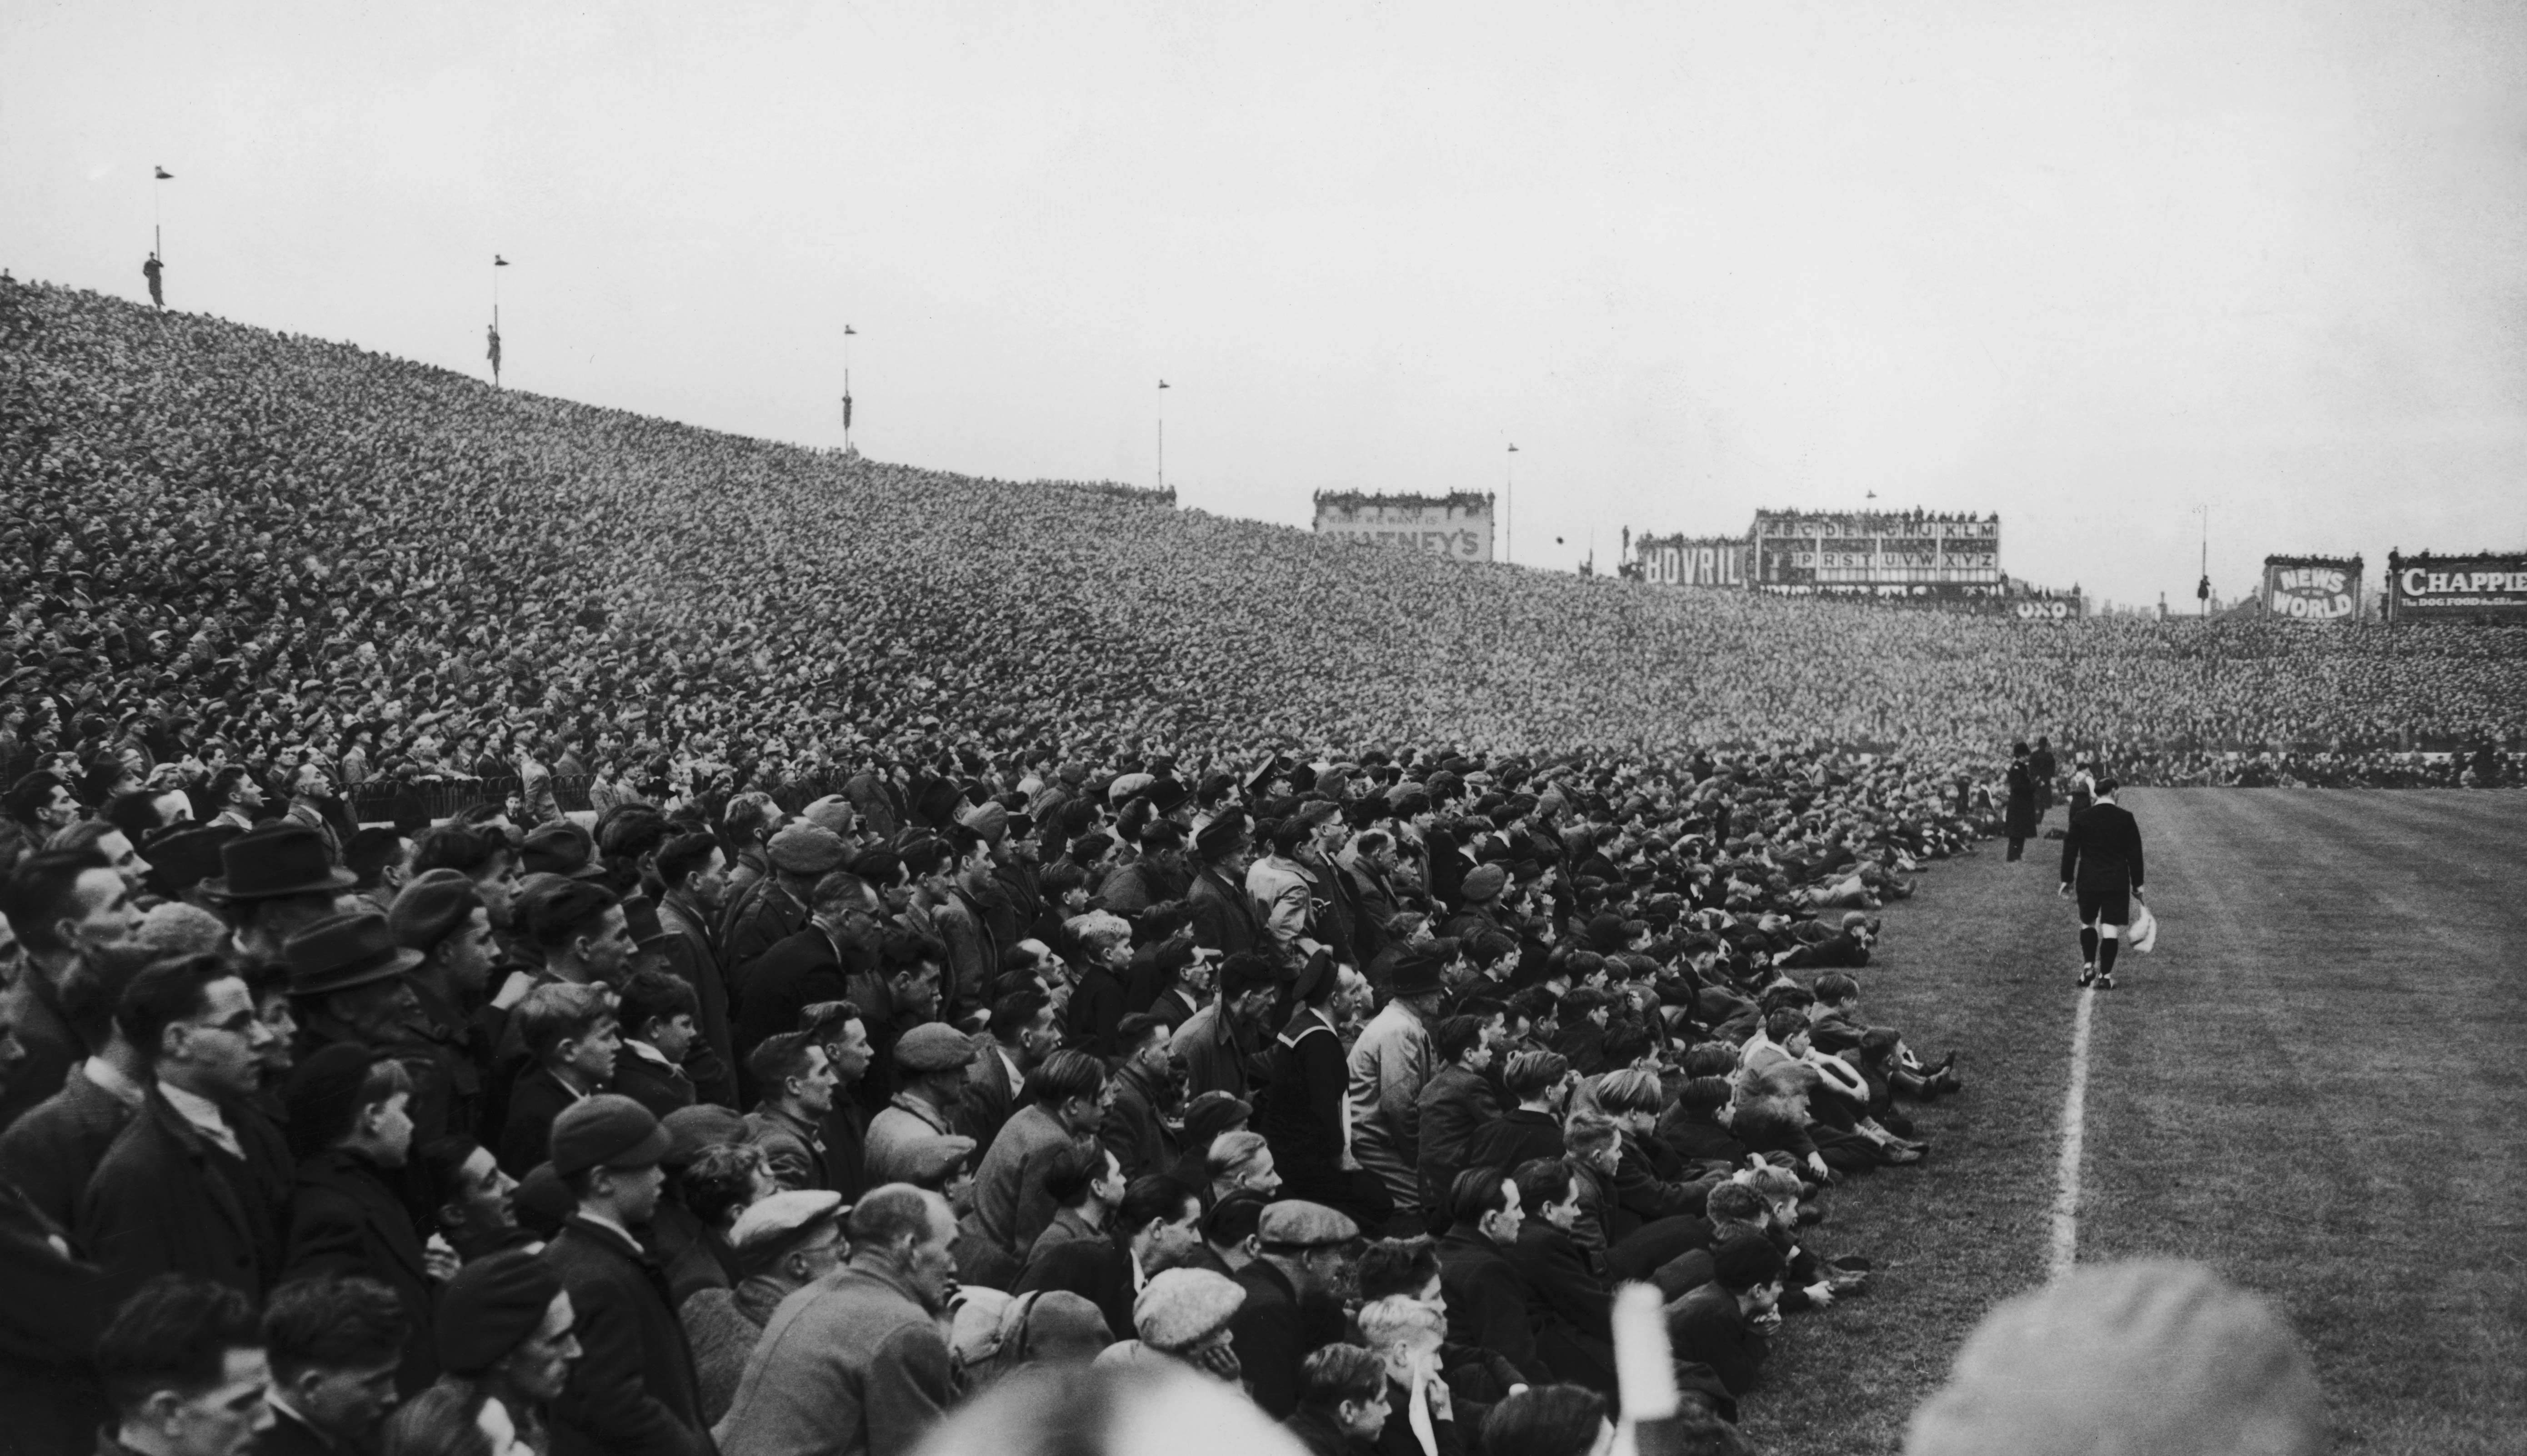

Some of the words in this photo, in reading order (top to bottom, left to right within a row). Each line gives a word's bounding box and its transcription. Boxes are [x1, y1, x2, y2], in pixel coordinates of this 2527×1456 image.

[1826, 524, 1835, 536] D
[1922, 524, 1932, 536] J
[1947, 524, 1955, 537] K
[1964, 525, 1974, 537] L
[1981, 525, 1994, 537] M
[1646, 547, 1740, 585] BOVRIL
[1803, 554, 1811, 566] P
[1825, 554, 1835, 566] R
[1843, 554, 1853, 566] S
[1862, 554, 1871, 566] T
[1886, 554, 1895, 565] U
[1903, 554, 1913, 565] V
[1920, 554, 1933, 565] W
[1945, 553, 1955, 566] X
[1962, 553, 1973, 566] Y
[1982, 554, 1992, 566] Z
[2280, 568, 2347, 593] NEWS
[2401, 567, 2527, 596] CHAPPIE
[2017, 602, 2067, 618] OXO
[2273, 590, 2352, 618] WORLD
[2419, 597, 2445, 606] DOG
[2446, 597, 2480, 606] FOOD
